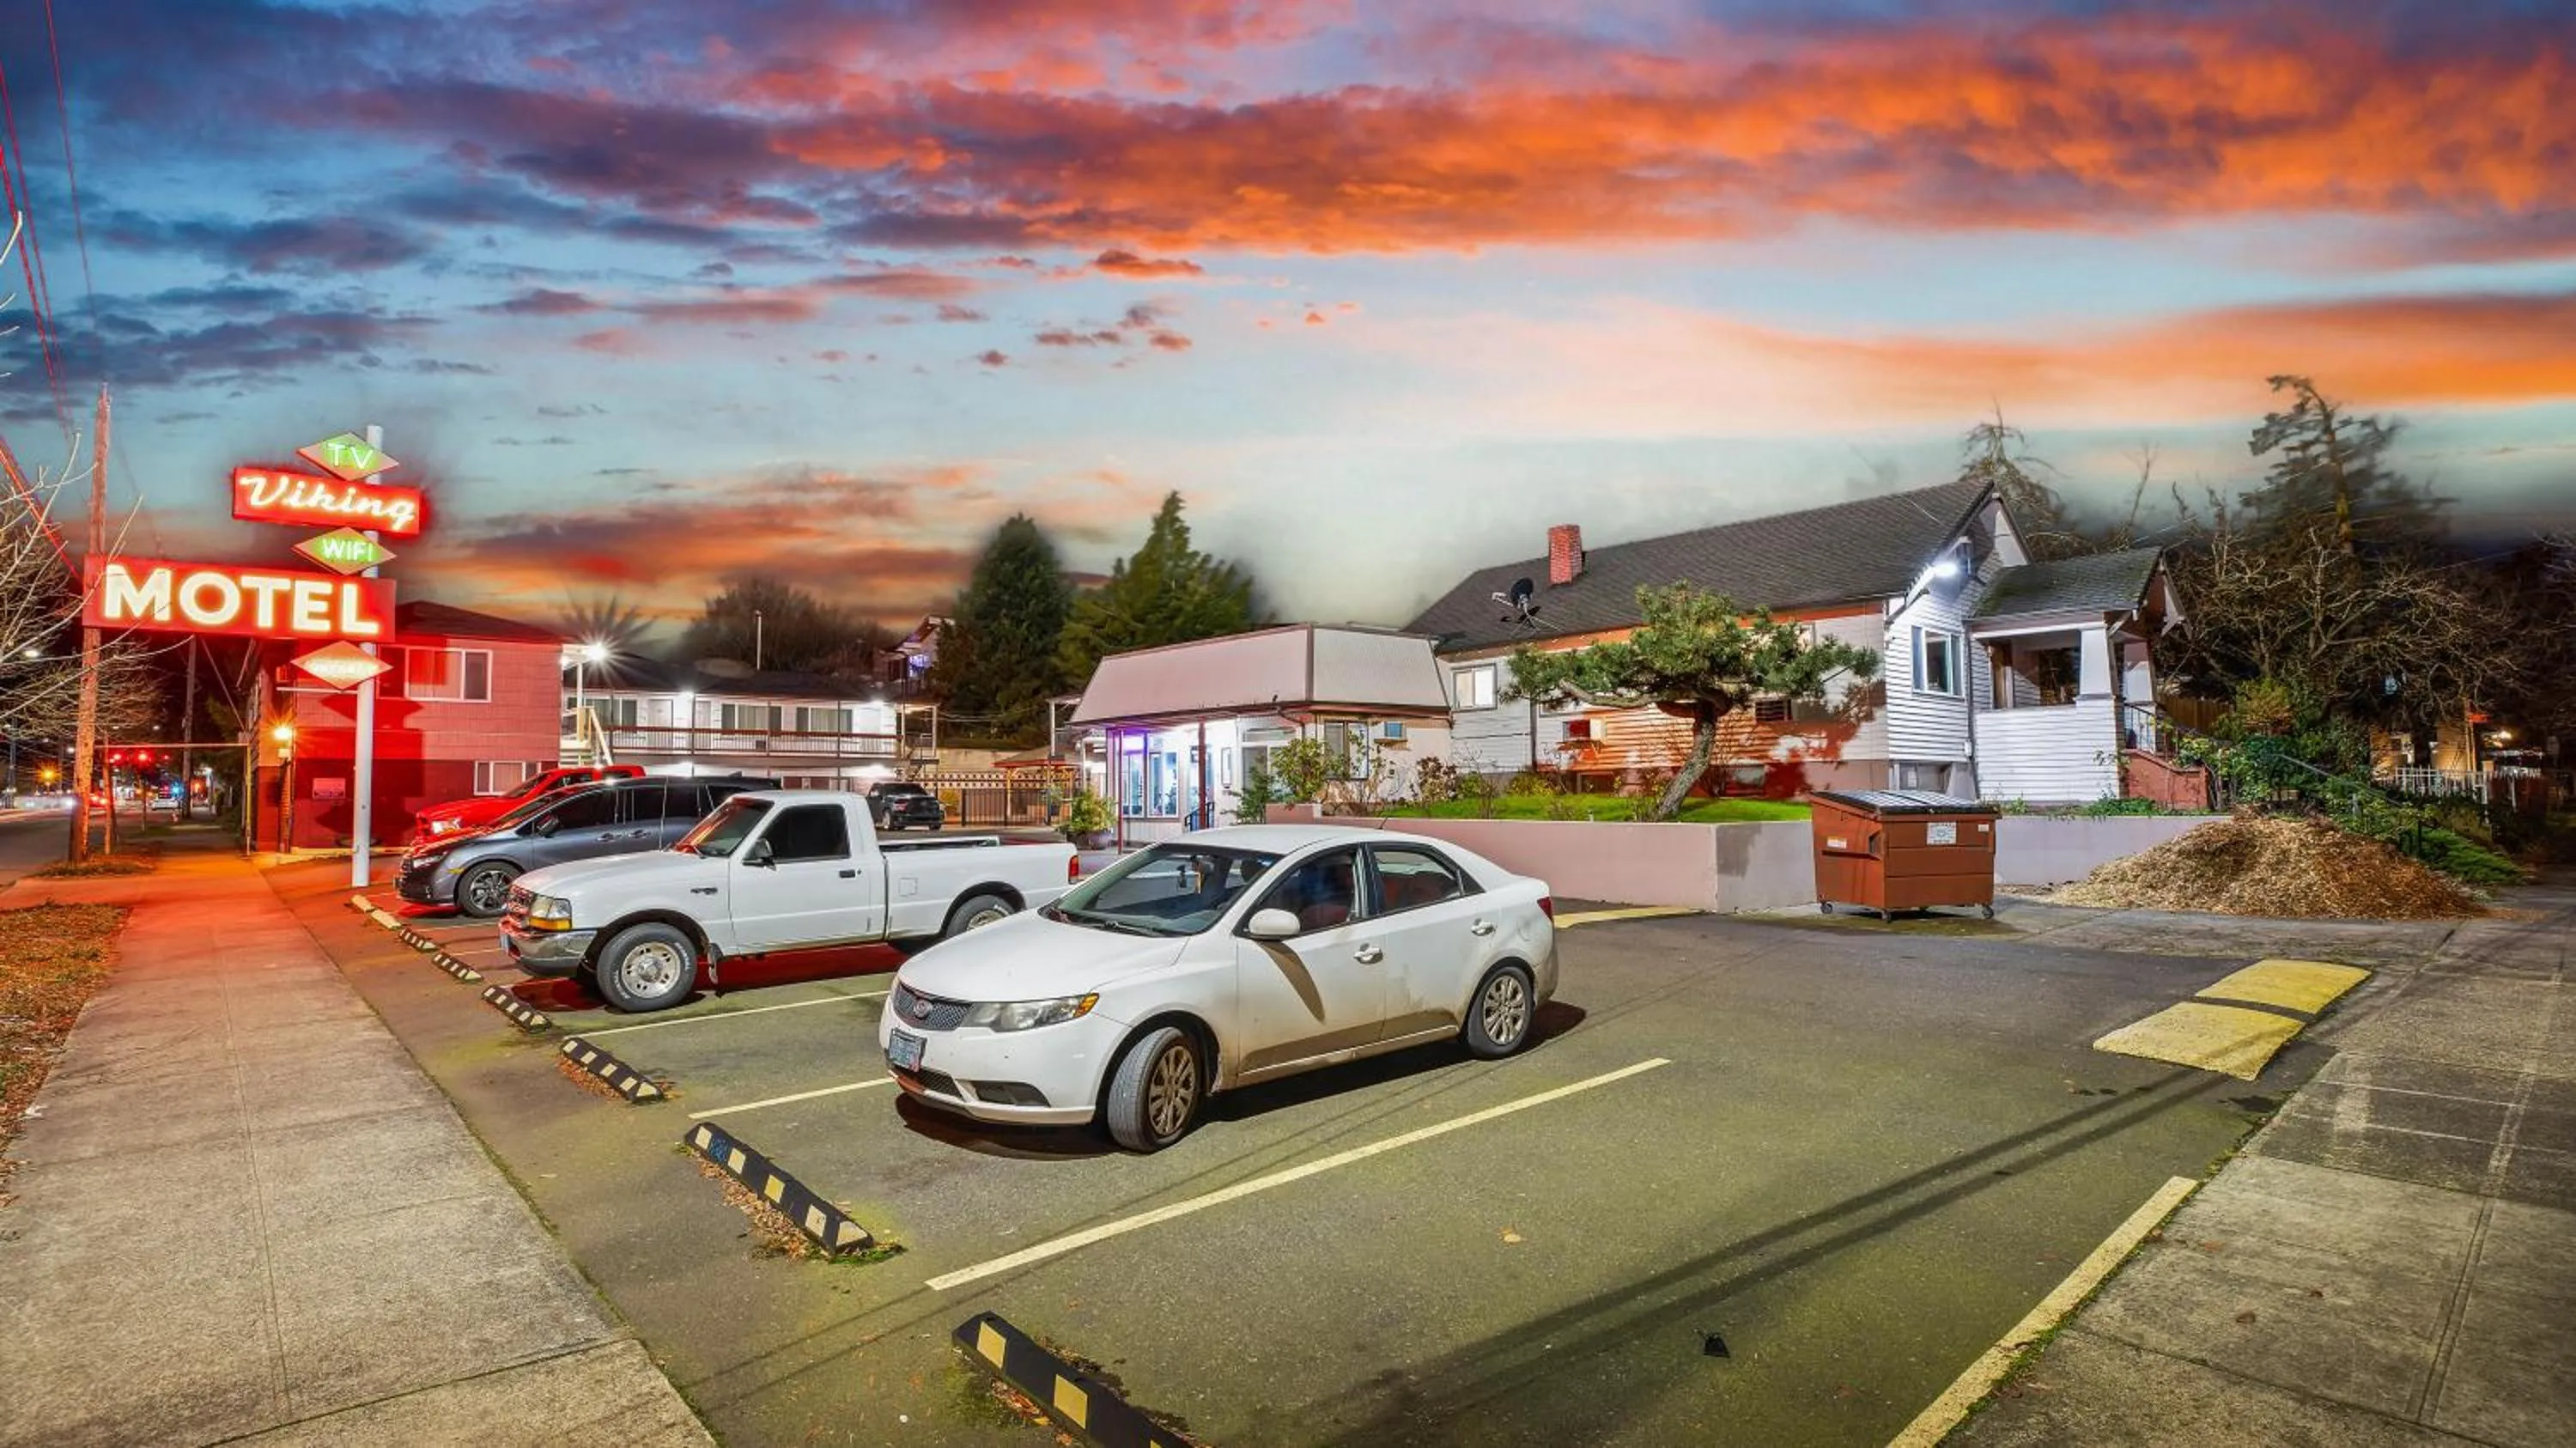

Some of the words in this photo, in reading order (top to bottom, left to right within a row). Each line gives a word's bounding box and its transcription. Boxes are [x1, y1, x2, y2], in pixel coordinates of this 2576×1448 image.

[326, 442, 374, 469] TV
[240, 476, 416, 530] Viking
[322, 539, 373, 562] WIFI
[104, 563, 380, 635] MOTEL
